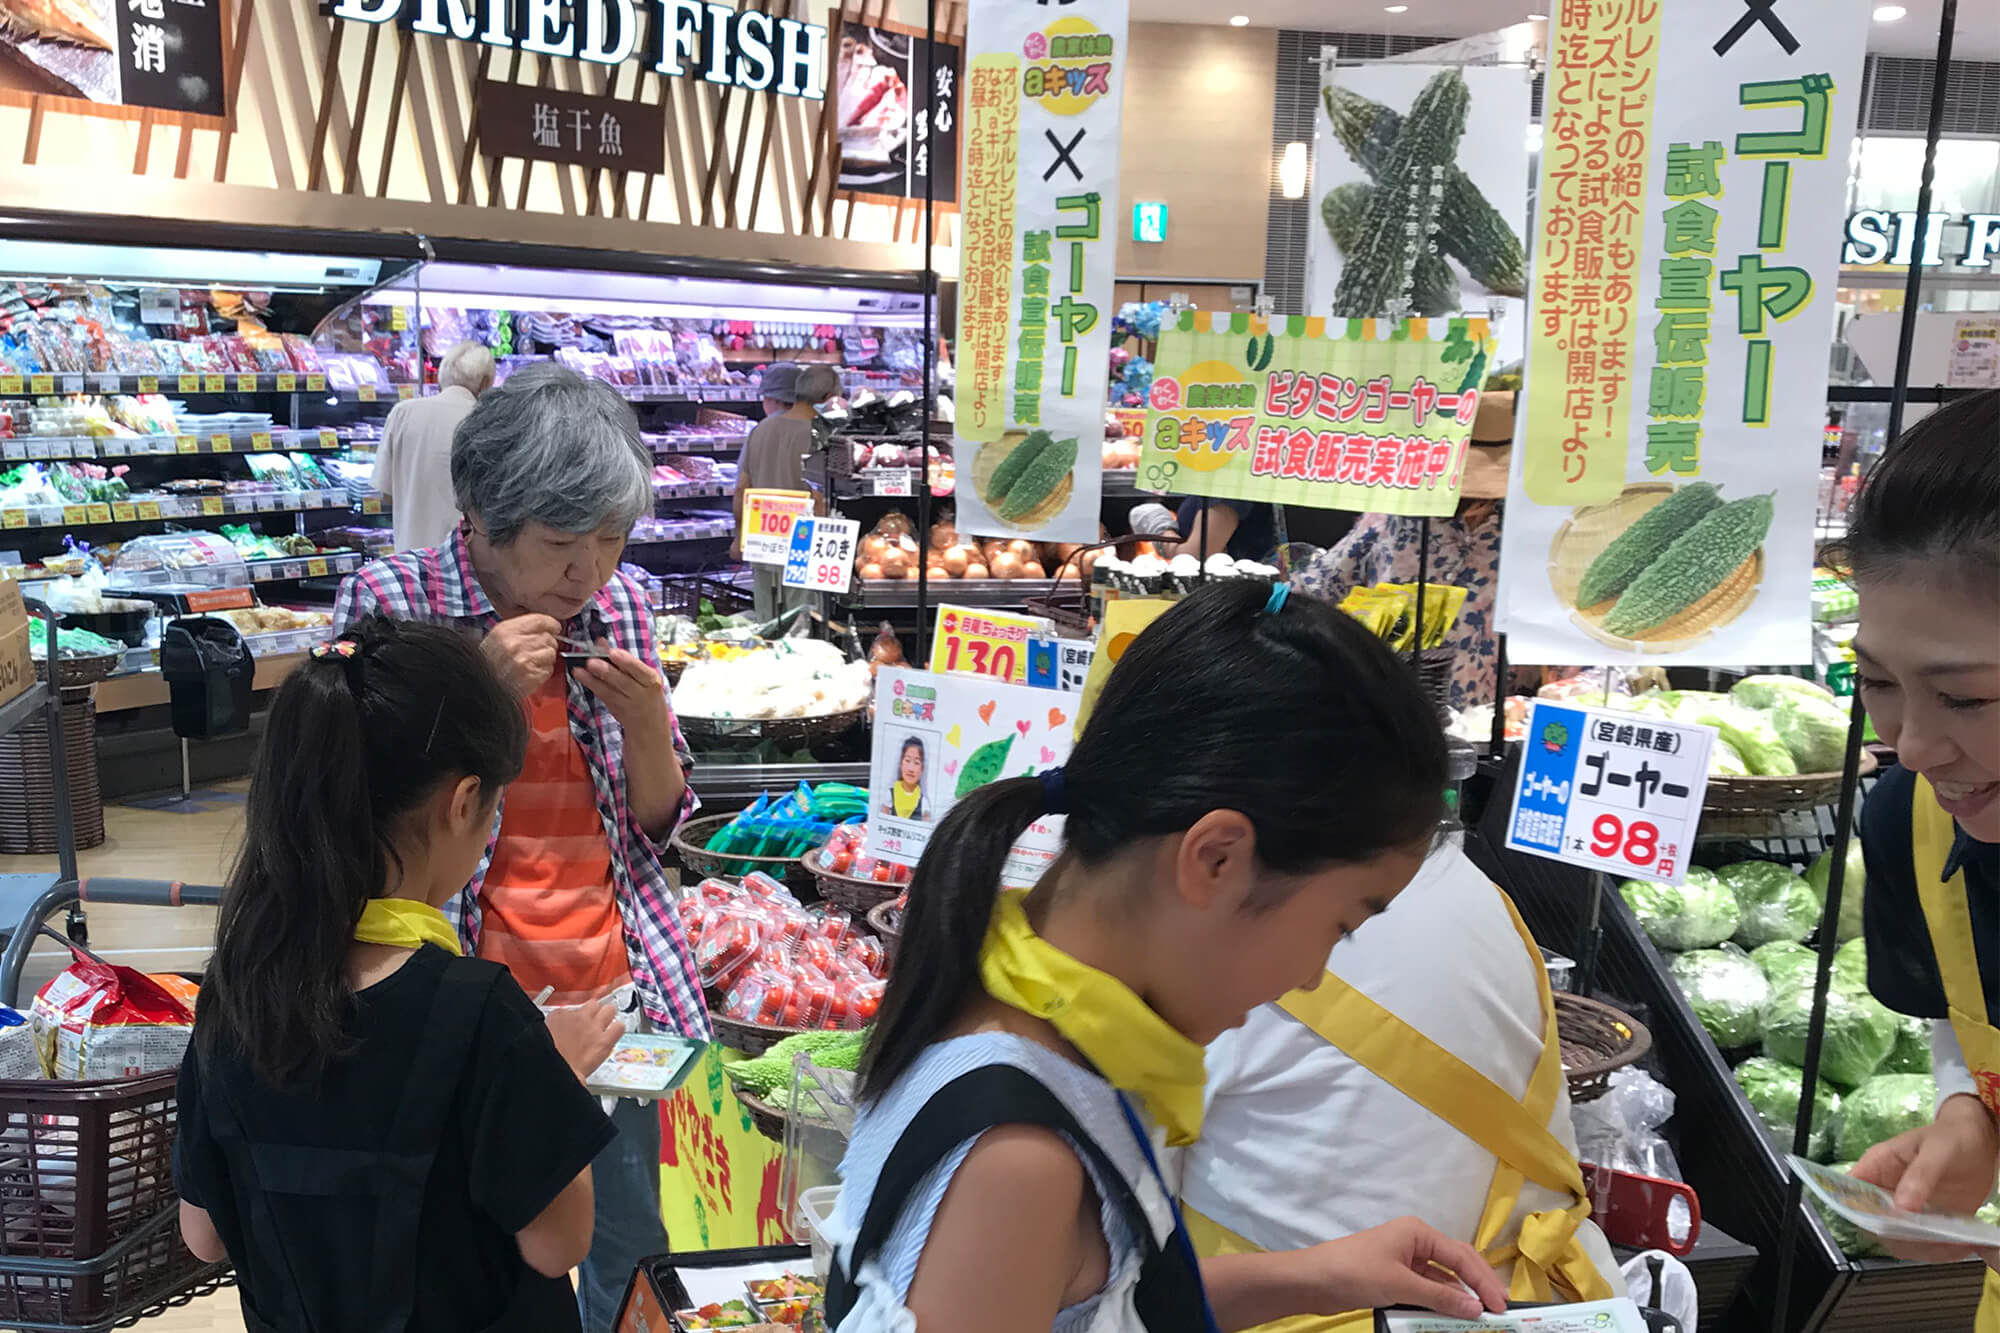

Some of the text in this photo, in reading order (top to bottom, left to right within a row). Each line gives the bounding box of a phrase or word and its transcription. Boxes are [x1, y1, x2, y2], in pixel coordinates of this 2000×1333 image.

[655, 0, 826, 99] FISH
[935, 65, 953, 132] 安心
[1024, 62, 1112, 96] aキッズ
[532, 103, 624, 157] 塩干魚
[1720, 72, 1836, 424] ゴーヤー
[1052, 192, 1102, 396] ゴーヤー
[1644, 141, 1725, 474] 試食宣伝販売
[1265, 370, 1479, 427] ビタミンゴーヤーの
[1154, 416, 1256, 451] aキッズ
[1251, 426, 1469, 490] 試食販売実施中！
[760, 512, 790, 534] 100
[813, 536, 850, 561] えのき
[817, 564, 840, 585] 98
[945, 636, 1015, 683] 130
[1590, 719, 1681, 754] （宮崎県産）
[1580, 750, 1690, 809] ゴーヤー
[1590, 813, 1660, 866] 98
